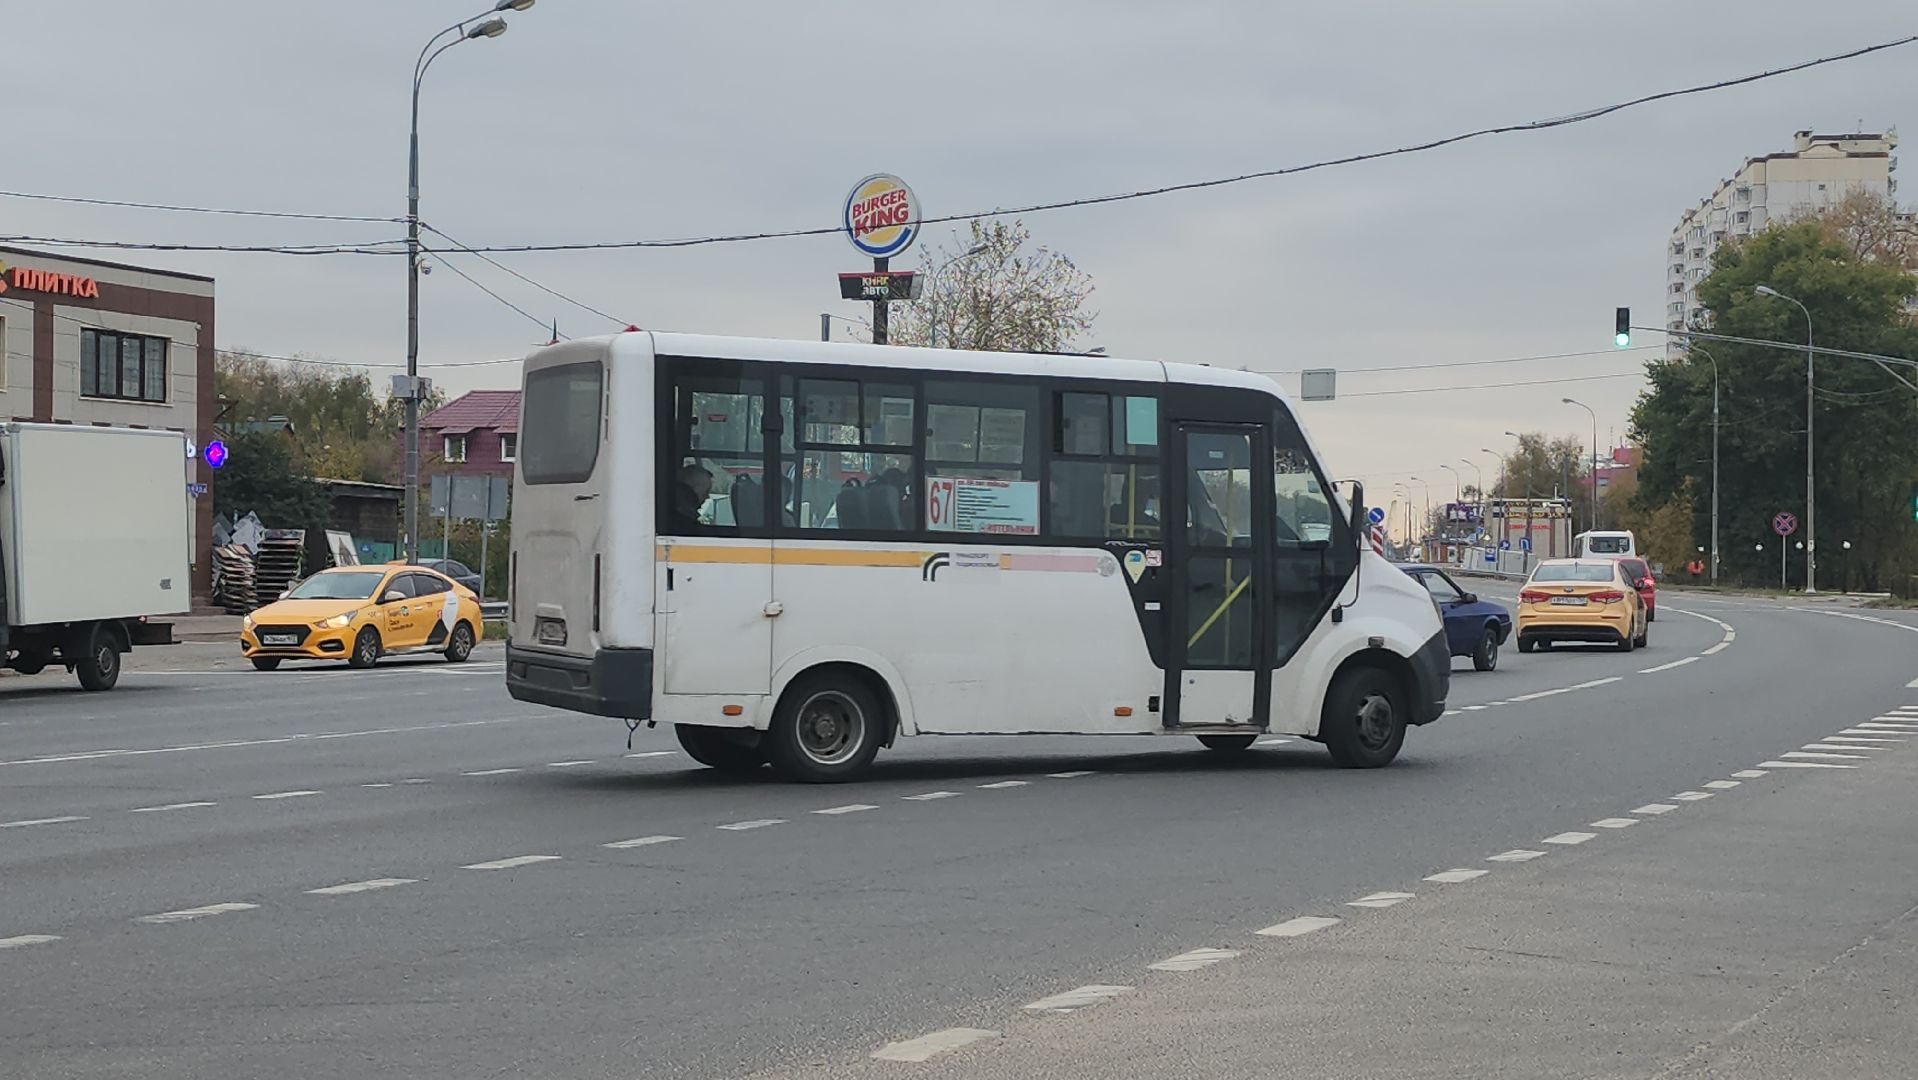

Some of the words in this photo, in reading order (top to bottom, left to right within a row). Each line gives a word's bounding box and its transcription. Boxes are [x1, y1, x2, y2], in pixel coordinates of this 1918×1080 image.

[852, 189, 907, 219] BURGER
[853, 202, 909, 239] KING
[12, 267, 99, 298] ПЛИТКА
[930, 480, 953, 525] 67
